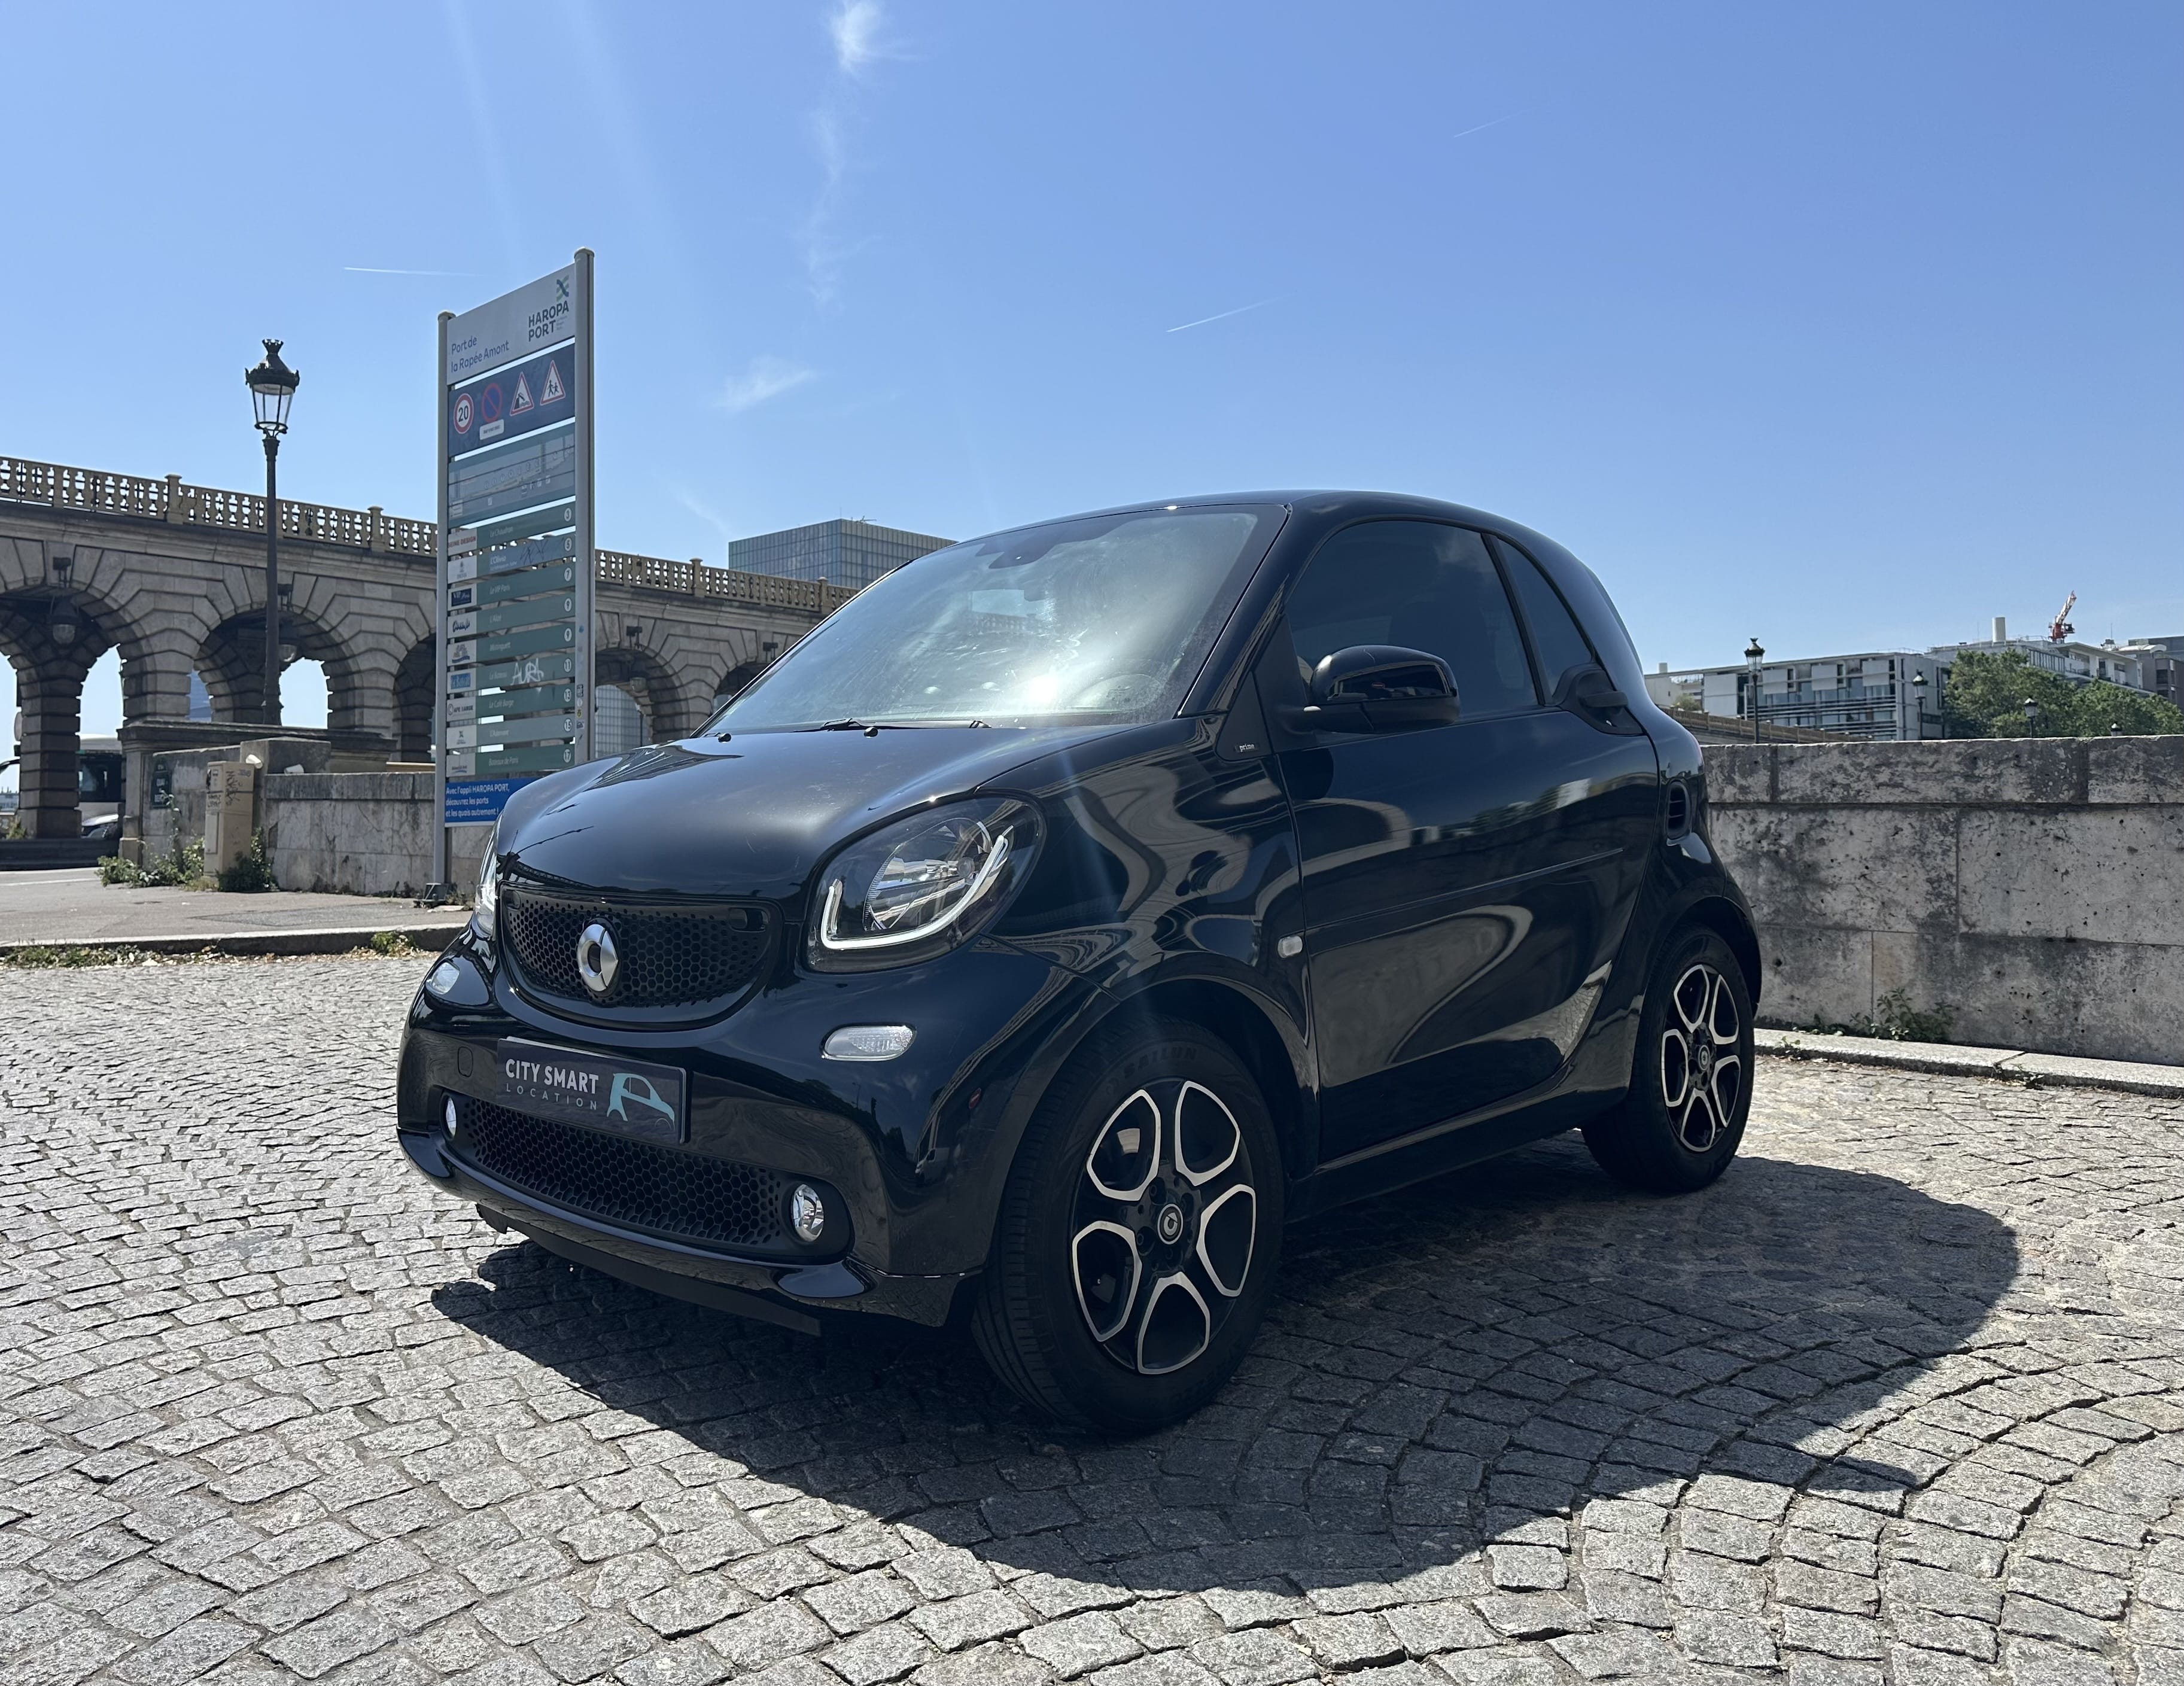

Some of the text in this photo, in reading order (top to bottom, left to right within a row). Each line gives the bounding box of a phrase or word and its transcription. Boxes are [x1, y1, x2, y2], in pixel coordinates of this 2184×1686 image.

[529, 300, 569, 327] HAROPA
[529, 319, 556, 342] PORT
[451, 336, 477, 355] Port de
[451, 340, 509, 372] la Rapée Amont
[458, 405, 469, 422] 20
[446, 787, 457, 795] Avec
[472, 784, 494, 793] HAROPA
[476, 797, 489, 806] ports
[458, 808, 471, 818] quais
[471, 808, 496, 817] autrement
[506, 1059, 599, 1094] CITY SMART
[506, 1082, 597, 1110] LOCATION
